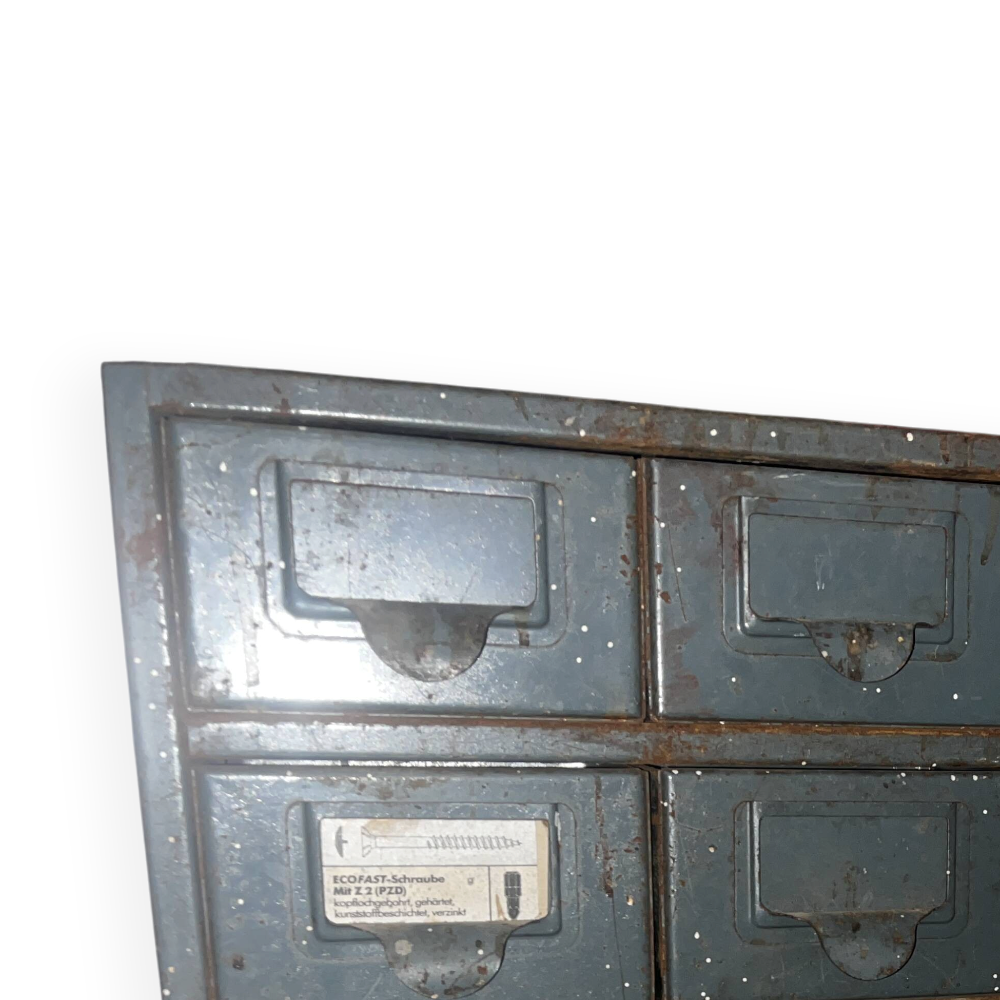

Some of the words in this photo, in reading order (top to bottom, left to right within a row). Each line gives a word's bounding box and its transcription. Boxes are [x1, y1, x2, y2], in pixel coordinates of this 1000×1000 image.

[333, 874, 446, 884] ECOFAST-Schraube
[334, 886, 352, 896] Mit
[354, 886, 363, 895] Z
[365, 886, 372, 895] 2
[375, 886, 407, 897] (PZD)
[431, 908, 467, 916] verzinkt
